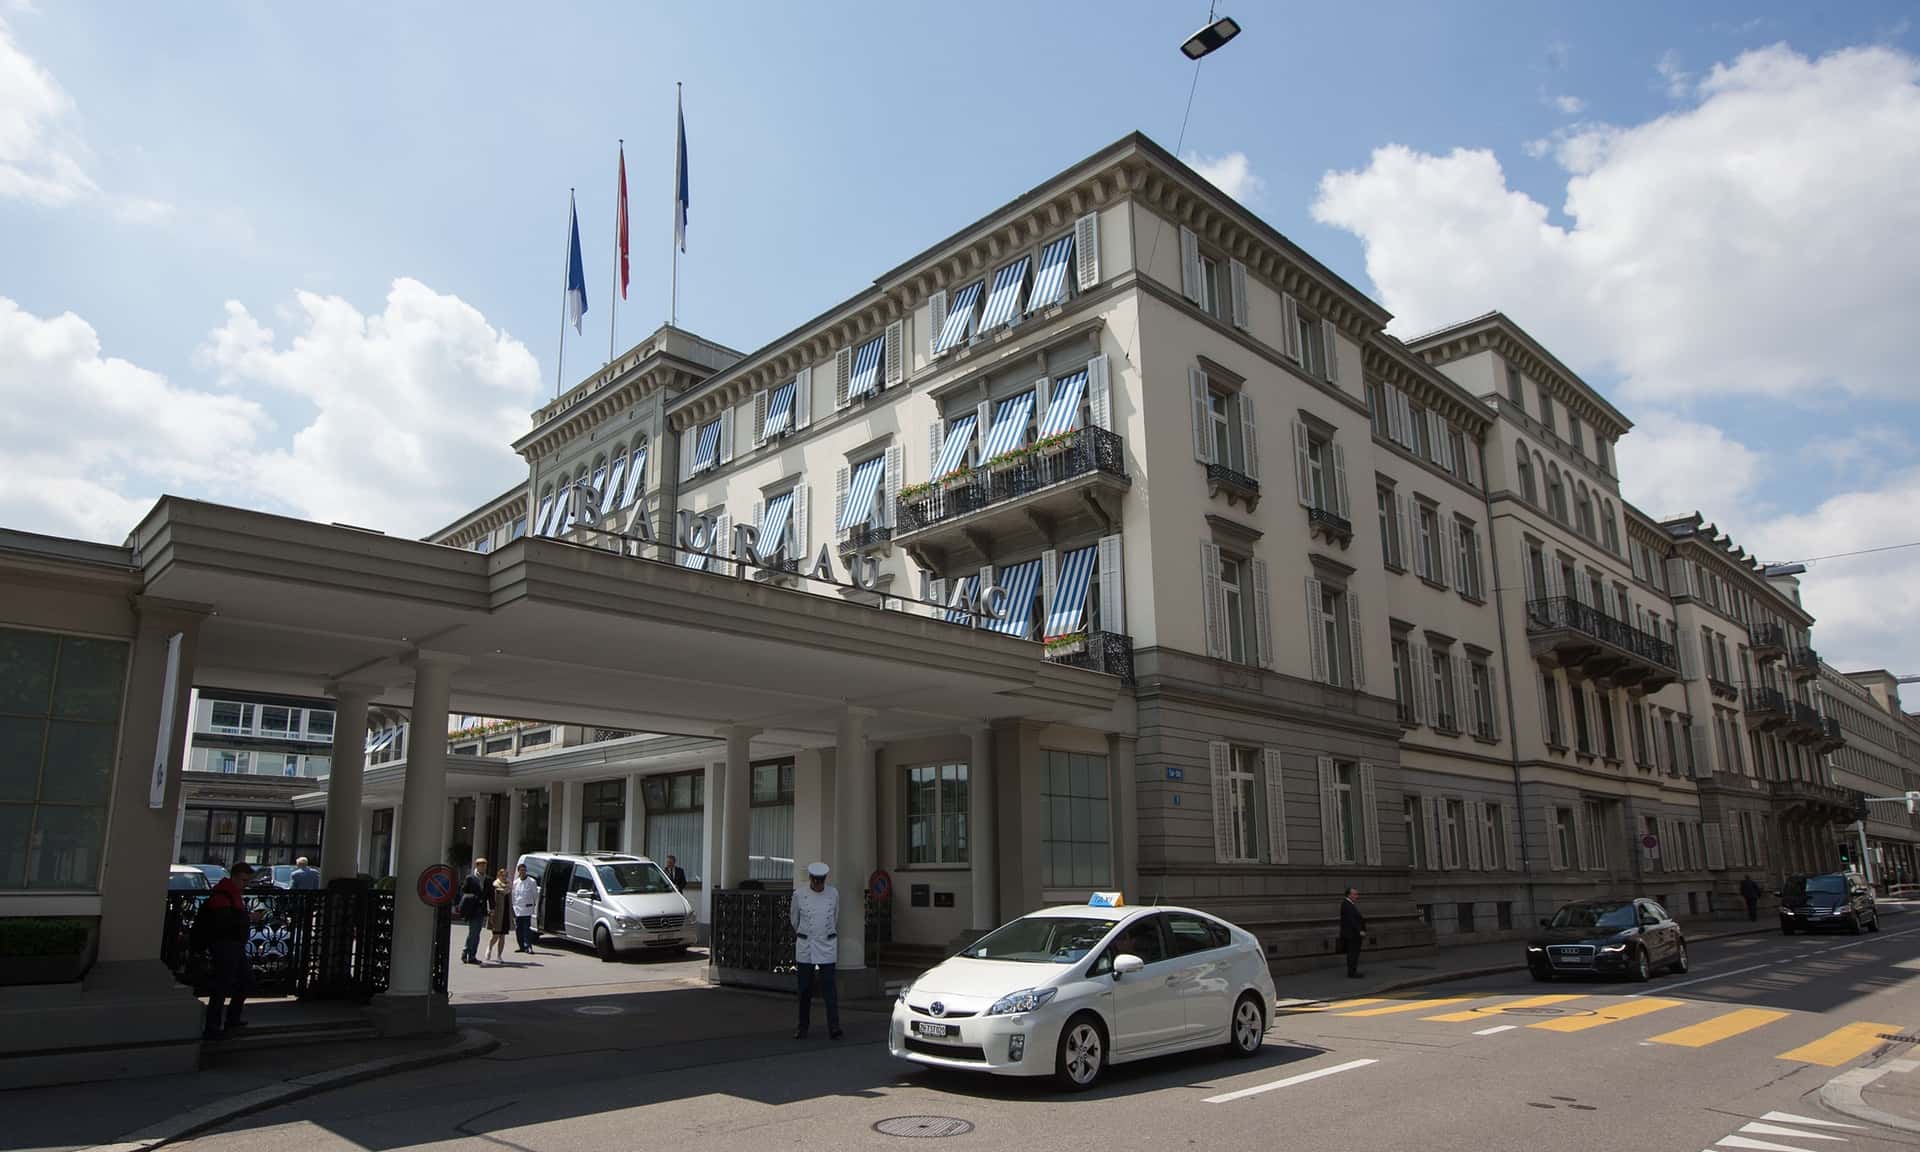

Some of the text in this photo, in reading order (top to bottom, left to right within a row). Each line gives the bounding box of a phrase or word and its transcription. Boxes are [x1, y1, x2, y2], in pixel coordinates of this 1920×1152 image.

[568, 484, 1008, 619] BAUR AU LAC
